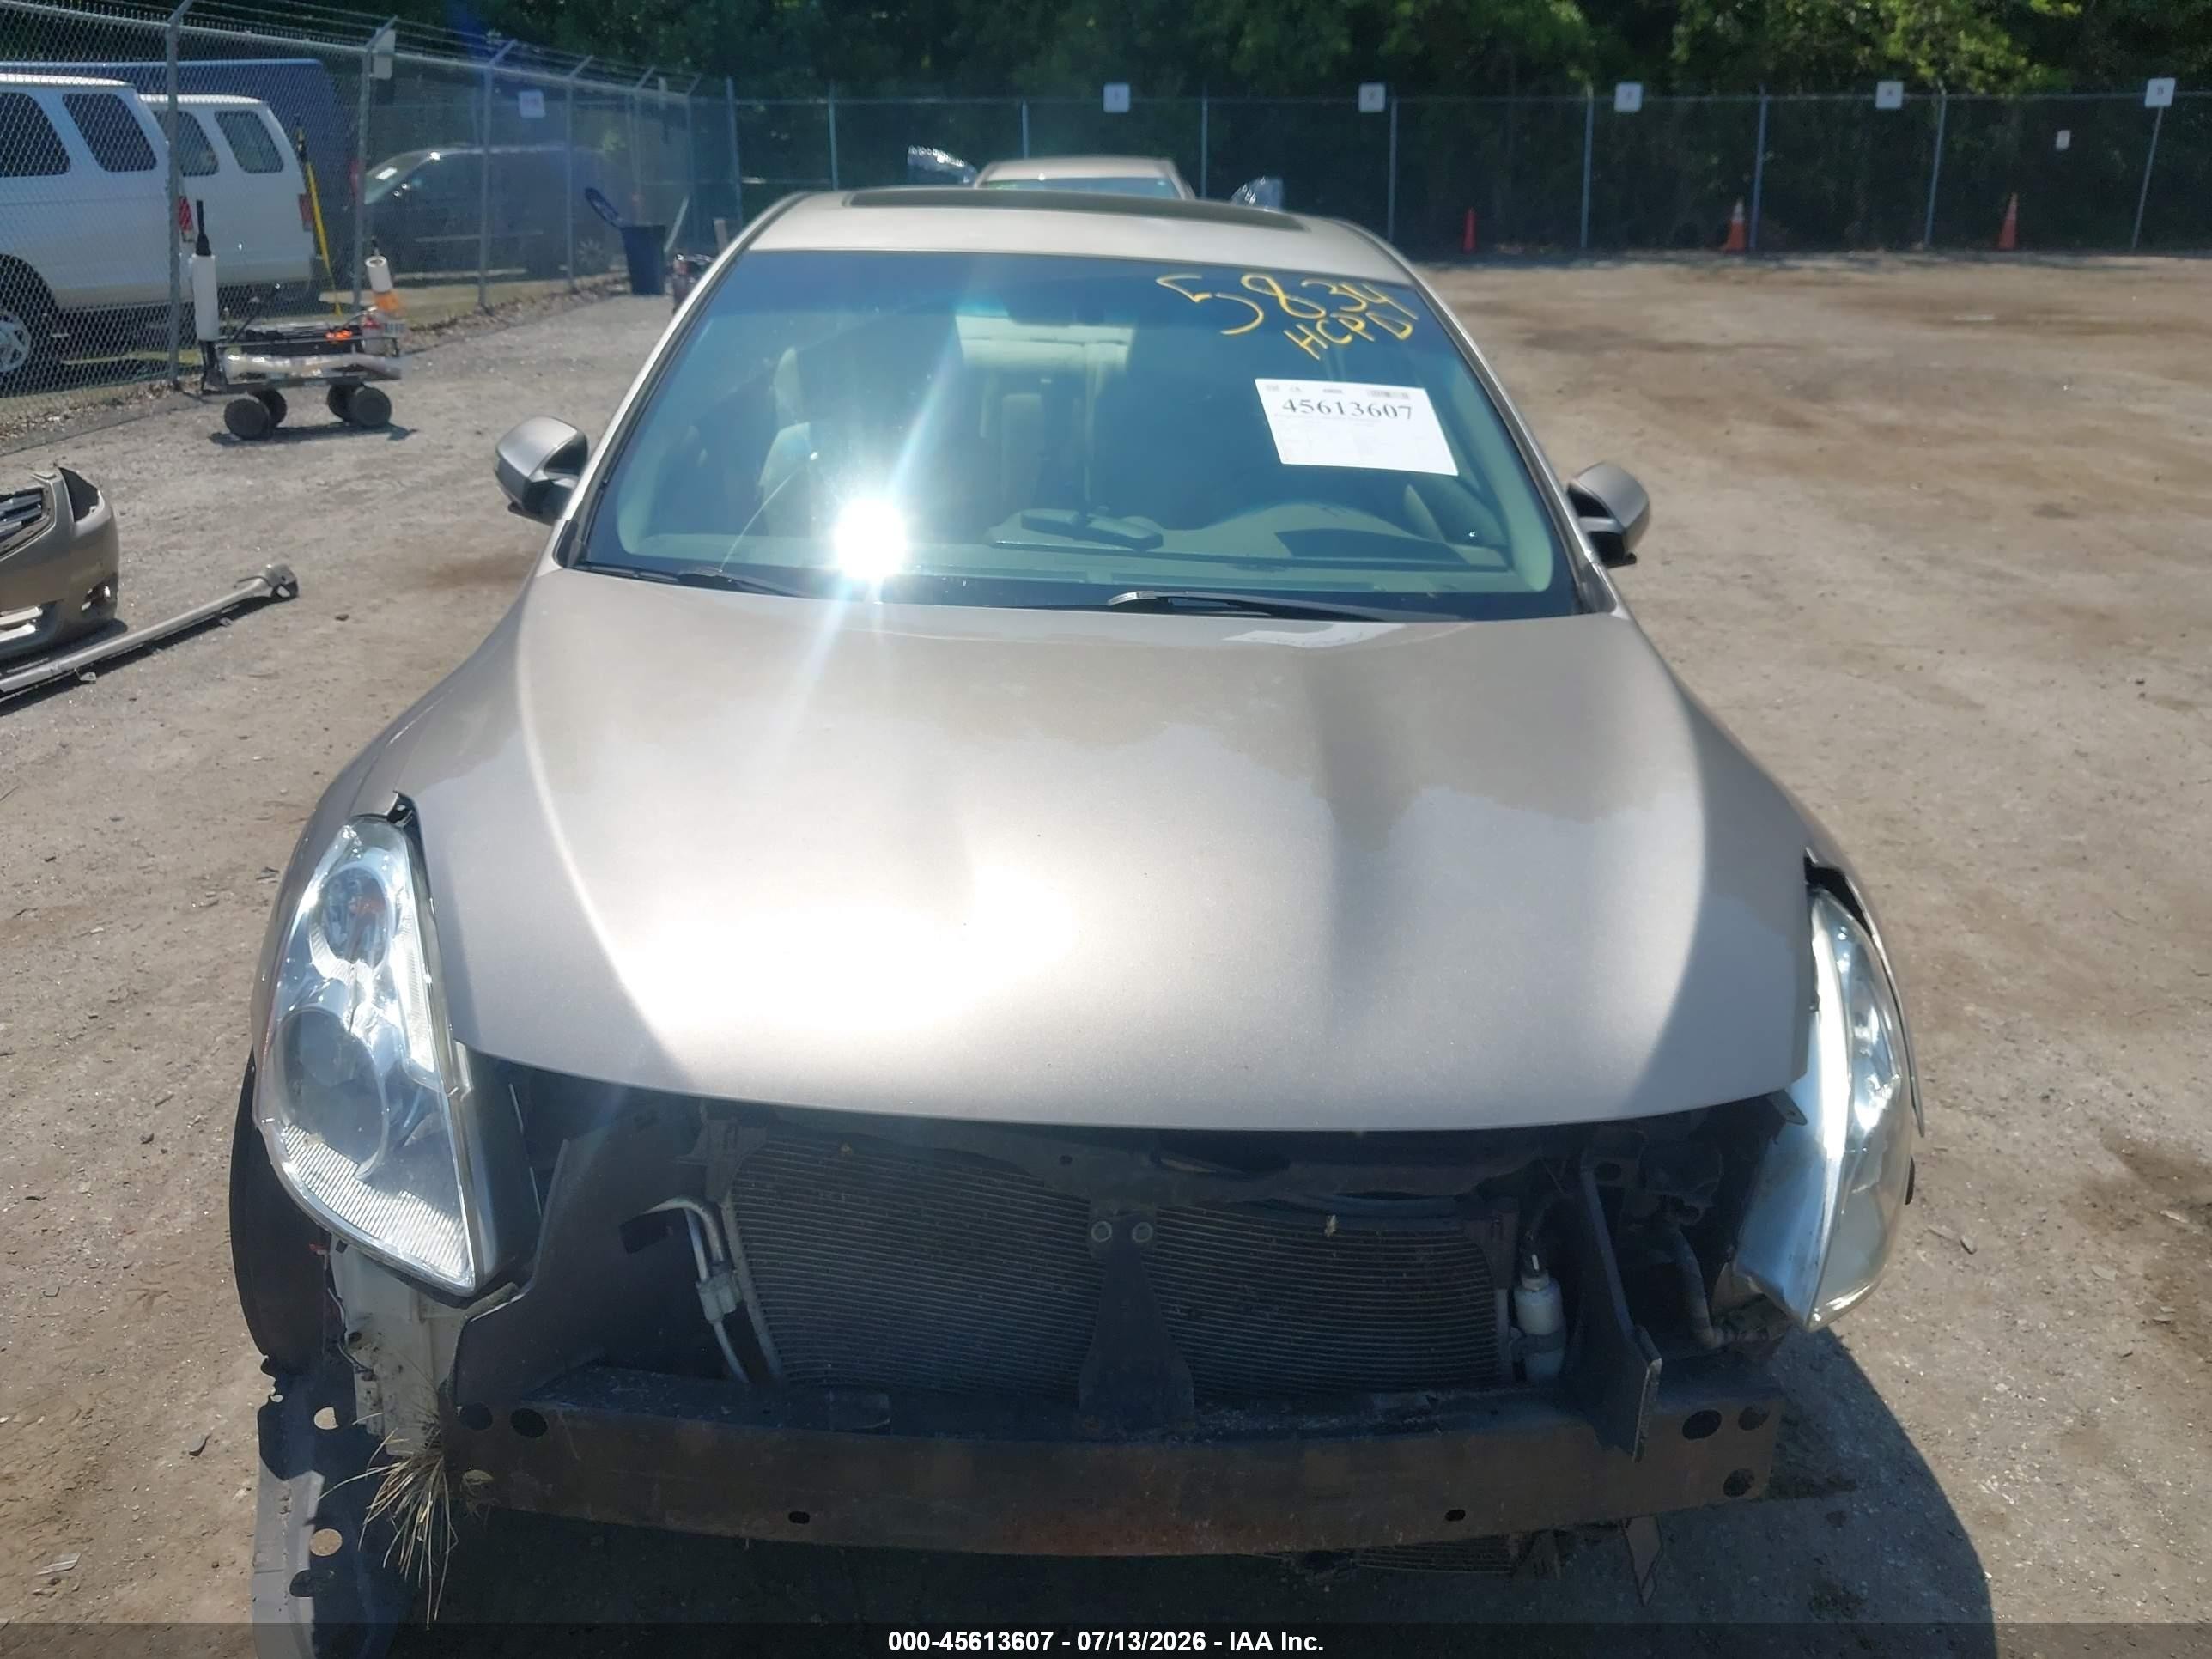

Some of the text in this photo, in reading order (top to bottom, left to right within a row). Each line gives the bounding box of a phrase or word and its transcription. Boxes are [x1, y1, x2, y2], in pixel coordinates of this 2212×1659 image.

[1156, 272, 1419, 336] 5834
[1283, 310, 1414, 361] HCPD
[1282, 398, 1413, 421] 45613607
